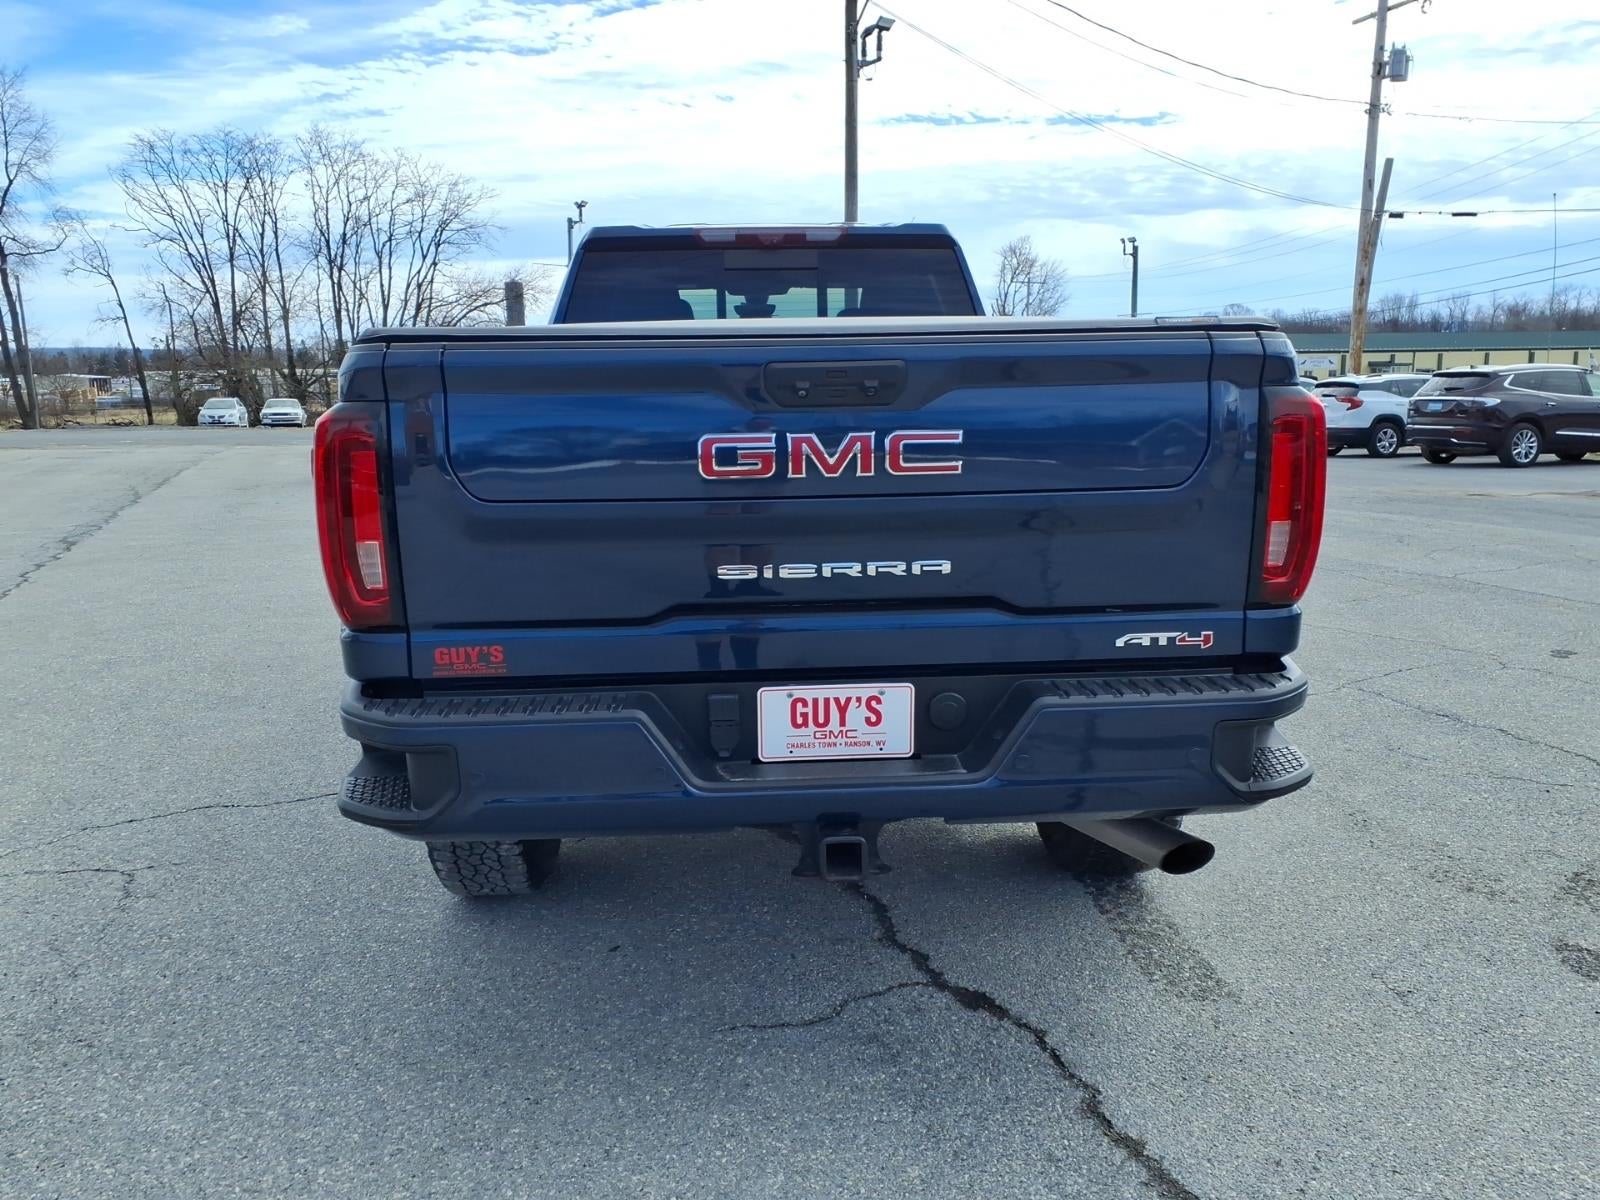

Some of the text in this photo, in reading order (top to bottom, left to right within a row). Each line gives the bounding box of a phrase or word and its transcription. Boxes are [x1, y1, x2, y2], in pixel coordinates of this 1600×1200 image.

[698, 430, 963, 479] GMC
[717, 560, 951, 579] SIERRA
[1115, 631, 1213, 649] AT4
[434, 645, 504, 664] GUY'S
[790, 695, 883, 729] GUY'S
[813, 729, 858, 739] GMC
[786, 742, 816, 750] CHARLES
[818, 741, 837, 749] TOWN
[875, 739, 887, 747] WV
